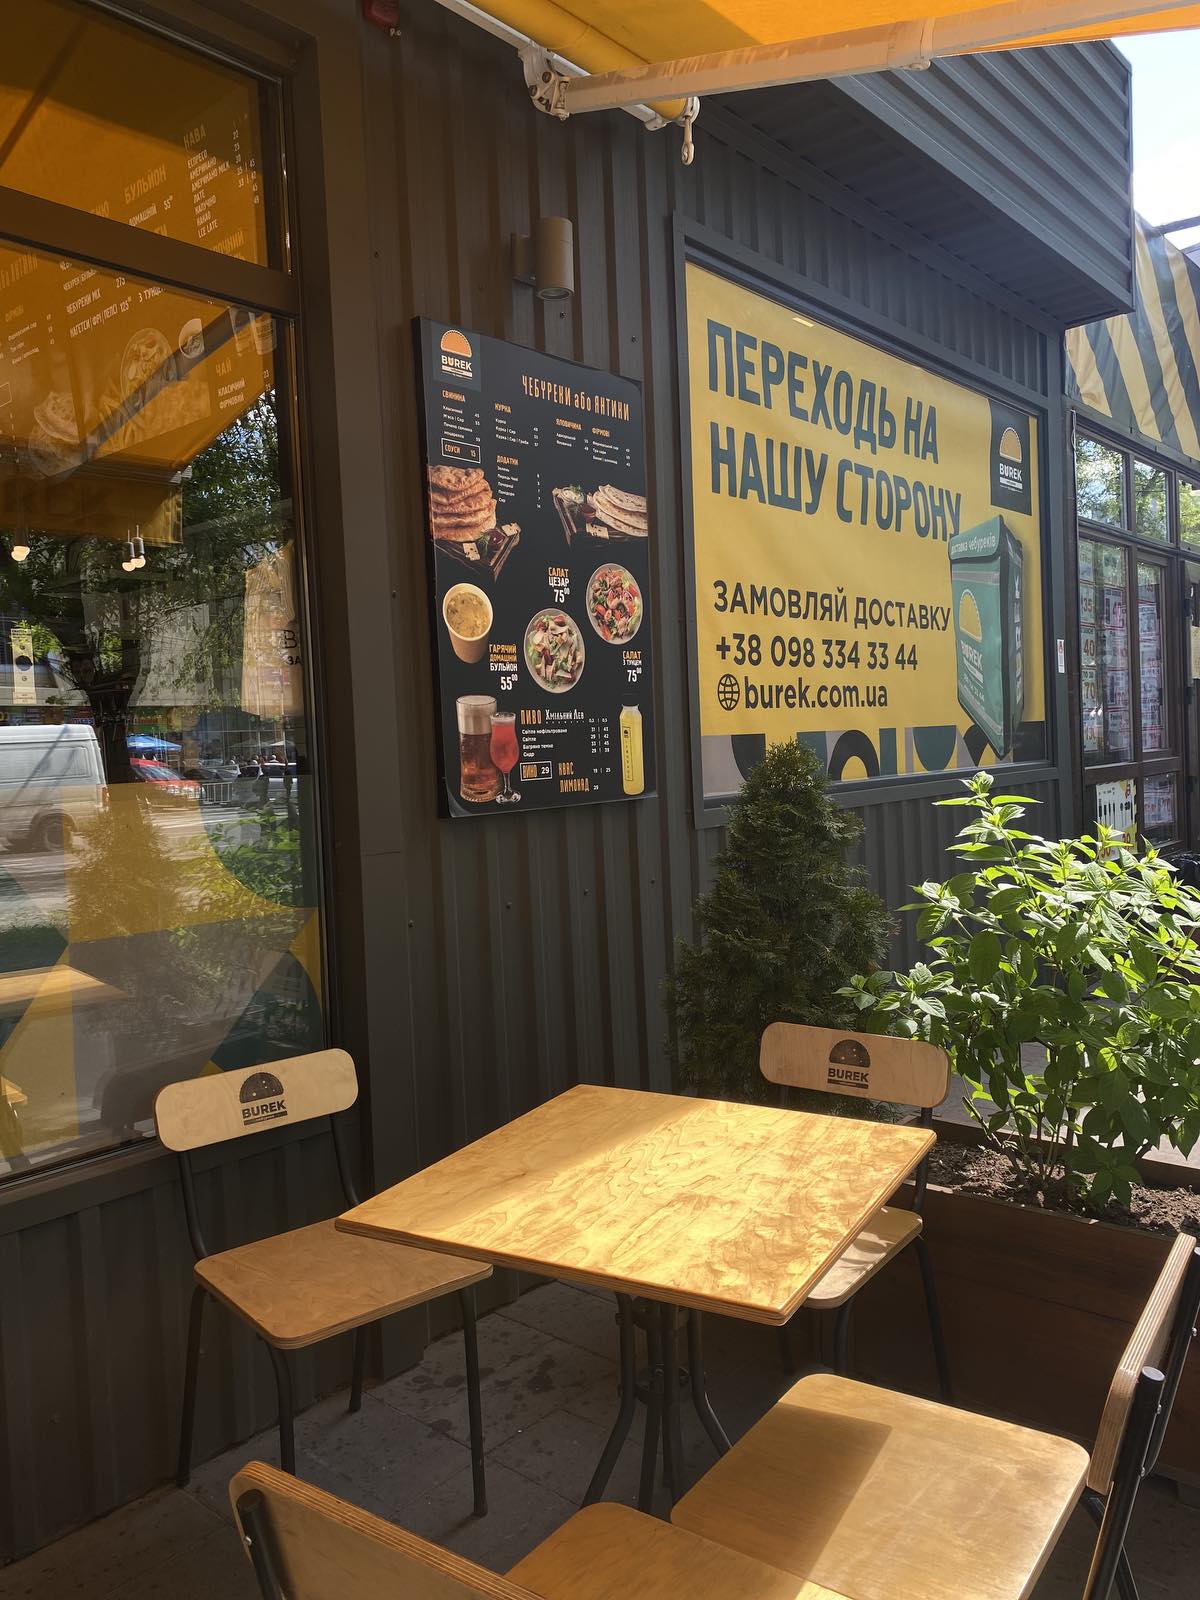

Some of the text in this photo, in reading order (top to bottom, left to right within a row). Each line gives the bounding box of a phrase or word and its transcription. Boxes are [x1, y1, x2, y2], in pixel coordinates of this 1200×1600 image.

[124, 162, 168, 205] БУЛЬЙОН
[441, 354, 473, 371] BUREK
[707, 318, 939, 464] ПЕРЕХОДЬ НА
[574, 391, 592, 412] або
[710, 421, 961, 542] НАШУ СТОРОНУ
[999, 463, 1022, 482] BUREK
[968, 532, 996, 553] чебуреків
[548, 566, 569, 578] САЛАТ
[548, 576, 570, 588] ЦЕЗАР
[713, 580, 951, 631] ЗАМОВЛЯЙ ДОСТАВКУ
[489, 643, 517, 654] ГАРЯЧИЙ
[622, 650, 642, 660] САЛАТ
[716, 633, 918, 670] +38 098 334 33 44
[490, 662, 519, 672] БУЛЬЙОН
[744, 675, 888, 709] burek.com.ua
[520, 709, 542, 725] ПИВО
[541, 766, 550, 775] 29
[829, 1068, 869, 1083] BUREK
[241, 1100, 287, 1120] BUREK
